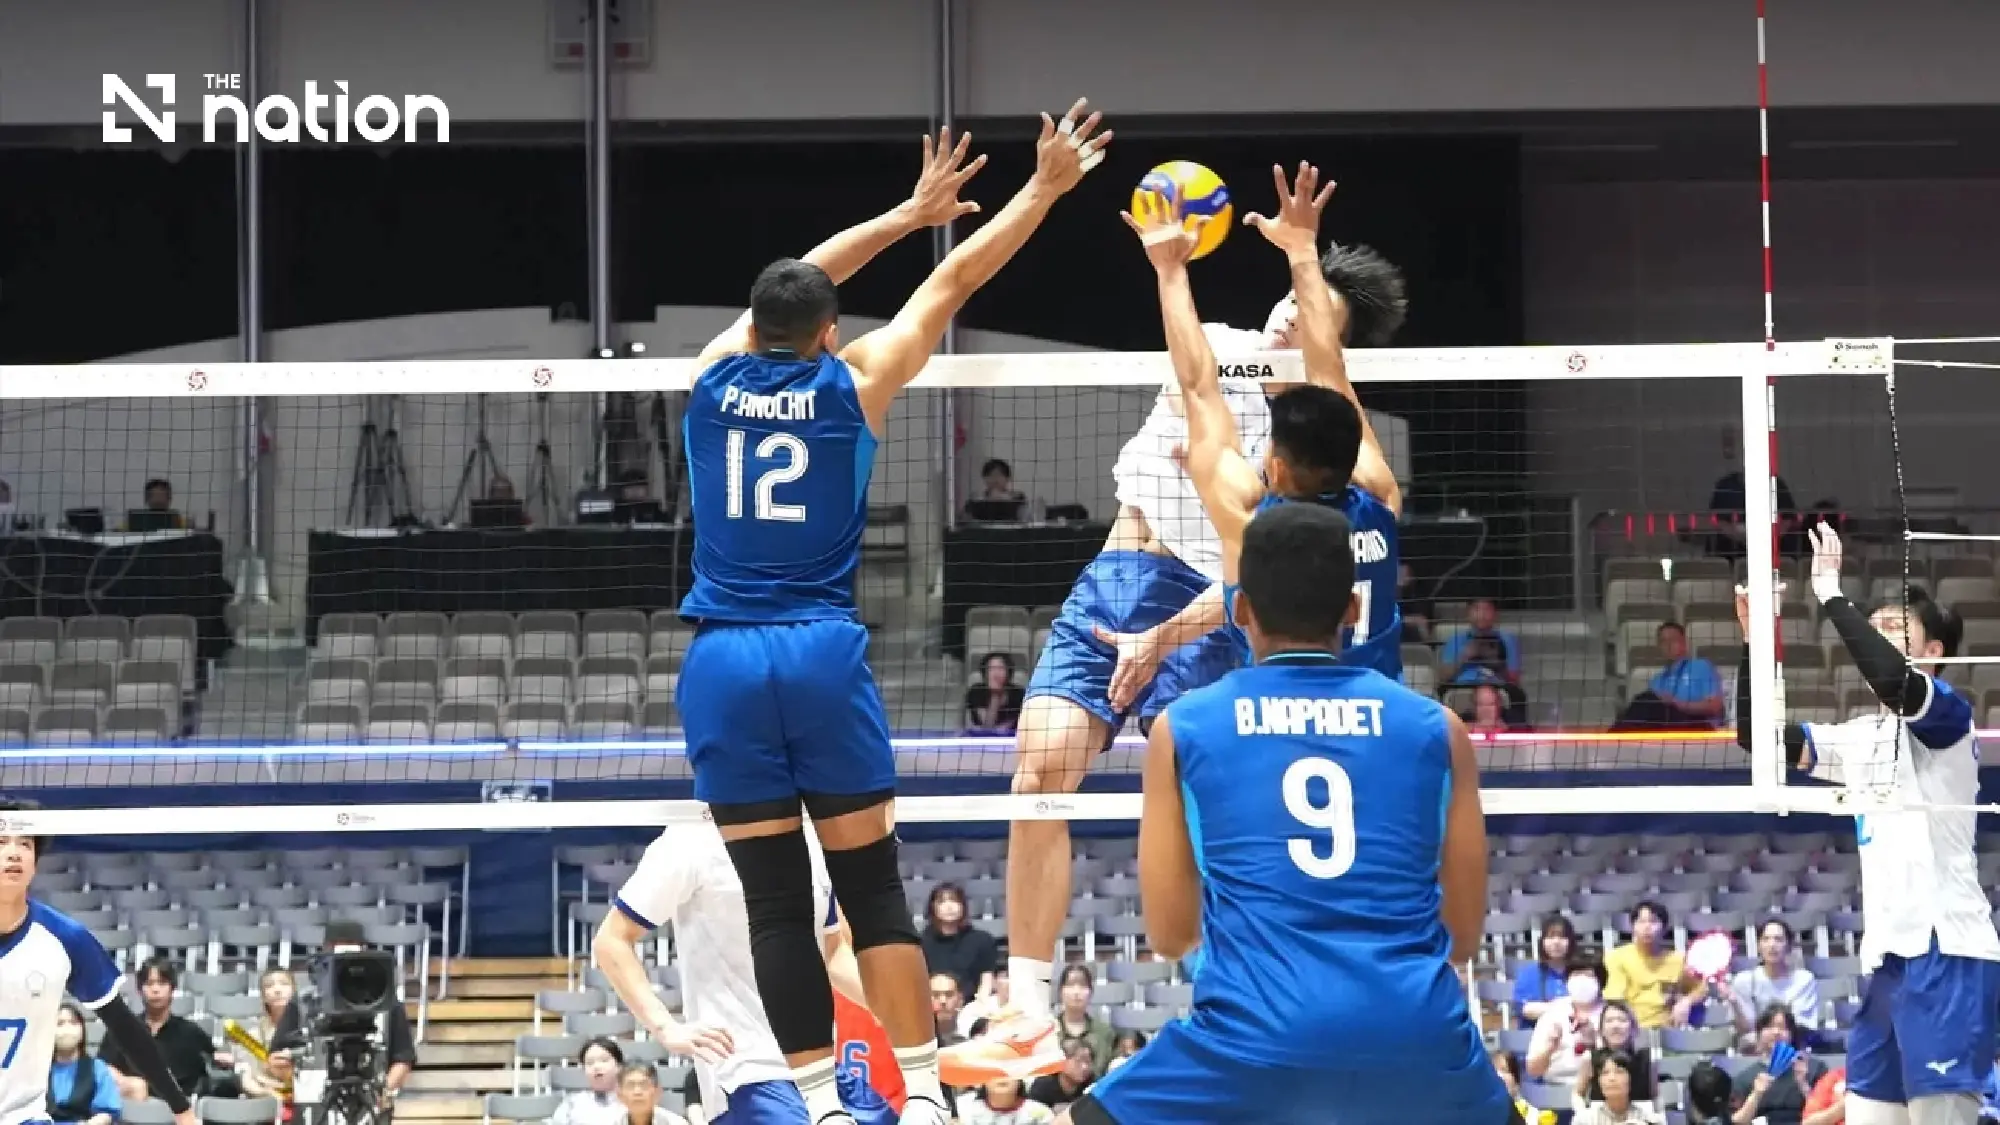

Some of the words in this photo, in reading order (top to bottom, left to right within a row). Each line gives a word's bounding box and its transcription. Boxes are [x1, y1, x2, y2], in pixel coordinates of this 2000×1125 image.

[1218, 364, 1275, 378] KASA
[726, 429, 809, 522] 12
[1234, 696, 1384, 737] B.NAPADET
[1282, 756, 1356, 880] 9
